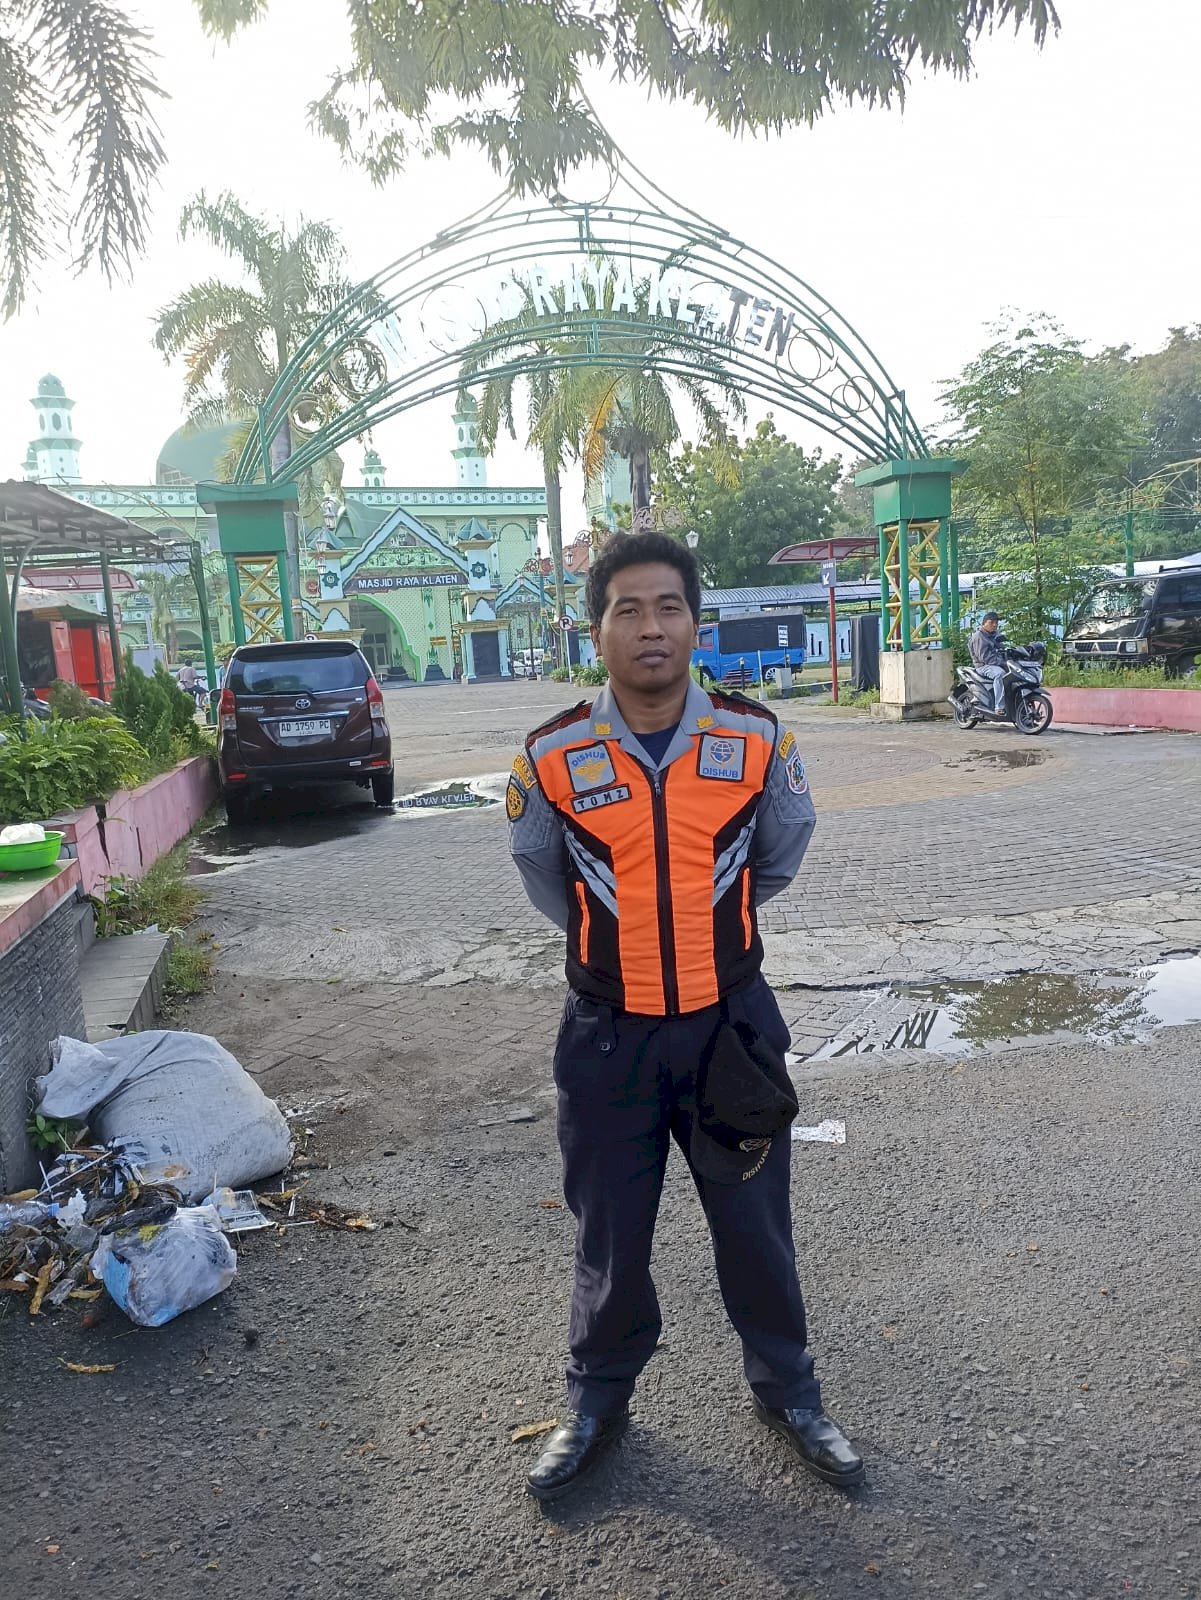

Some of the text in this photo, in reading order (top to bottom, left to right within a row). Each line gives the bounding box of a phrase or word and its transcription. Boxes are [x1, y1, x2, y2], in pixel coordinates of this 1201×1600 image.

[528, 260, 638, 316] RAYA
[358, 574, 458, 589] MASJID RAYA KLATEN
[281, 723, 291, 732] AD
[571, 750, 606, 767] DISHUB
[702, 767, 739, 778] DISHUB
